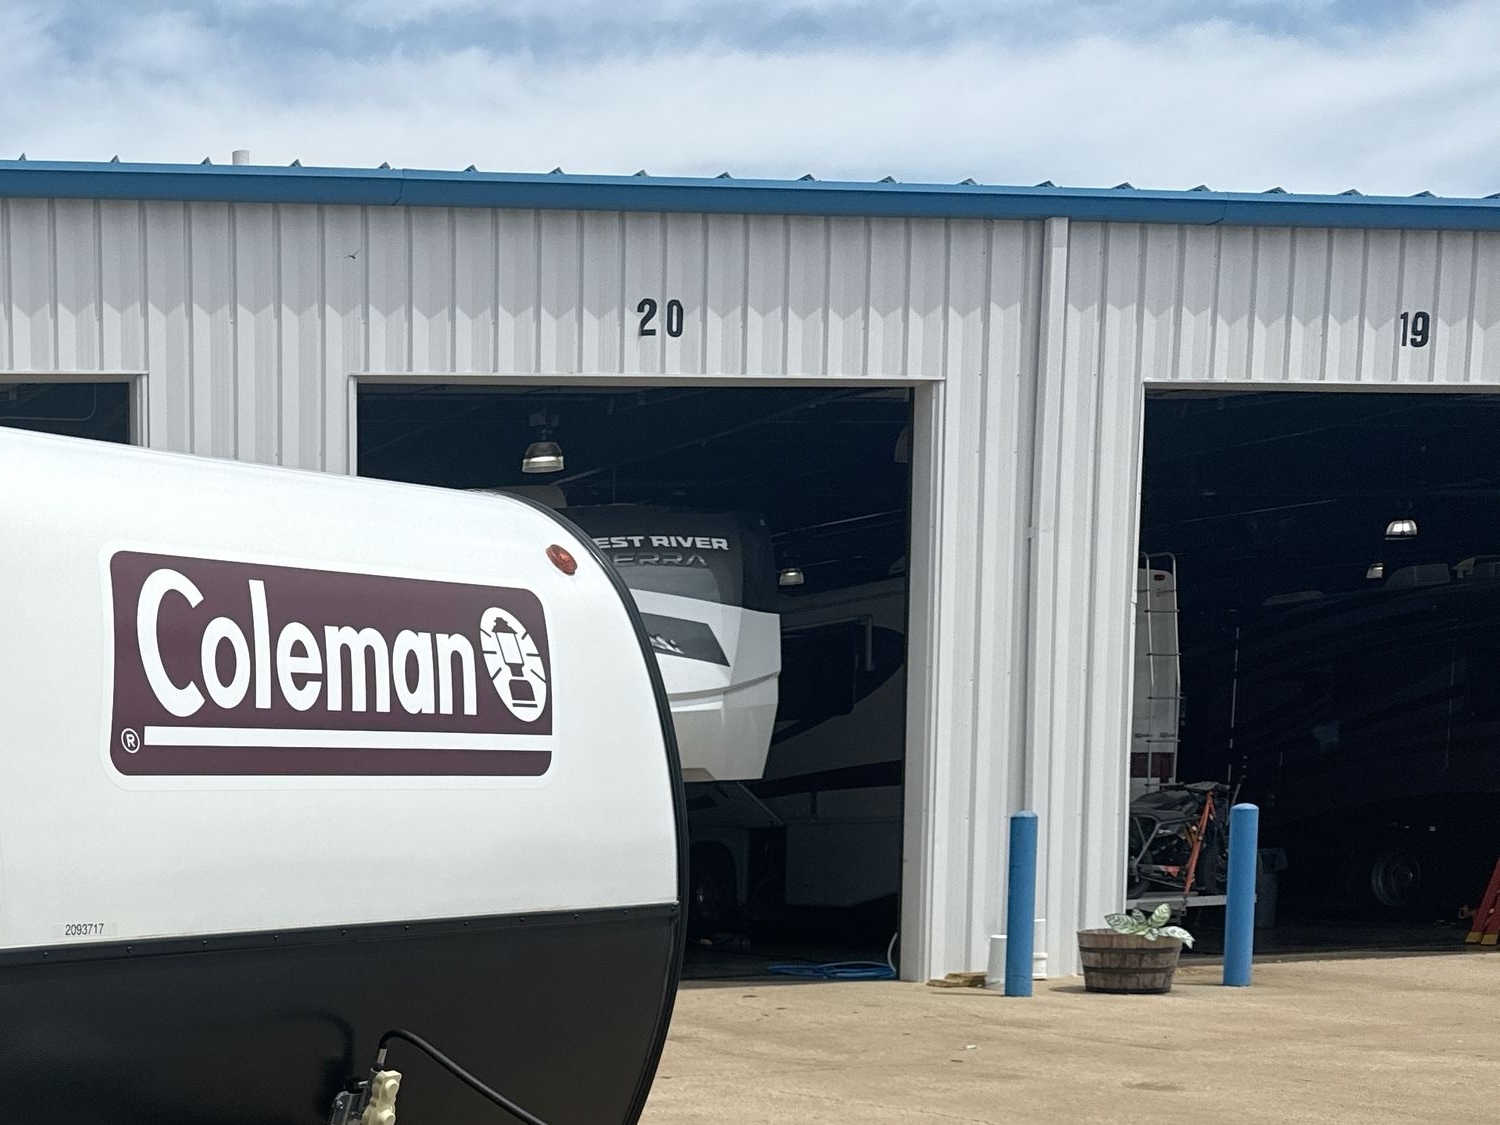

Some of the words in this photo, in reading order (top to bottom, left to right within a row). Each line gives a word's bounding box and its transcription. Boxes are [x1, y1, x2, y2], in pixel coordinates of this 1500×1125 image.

[637, 298, 683, 337] 20
[1400, 311, 1430, 347] 19
[592, 535, 645, 549] EST
[648, 535, 730, 551] RIVER
[611, 553, 708, 567] ERRA
[136, 568, 478, 718] Coleman
[65, 923, 104, 936] 2093717
